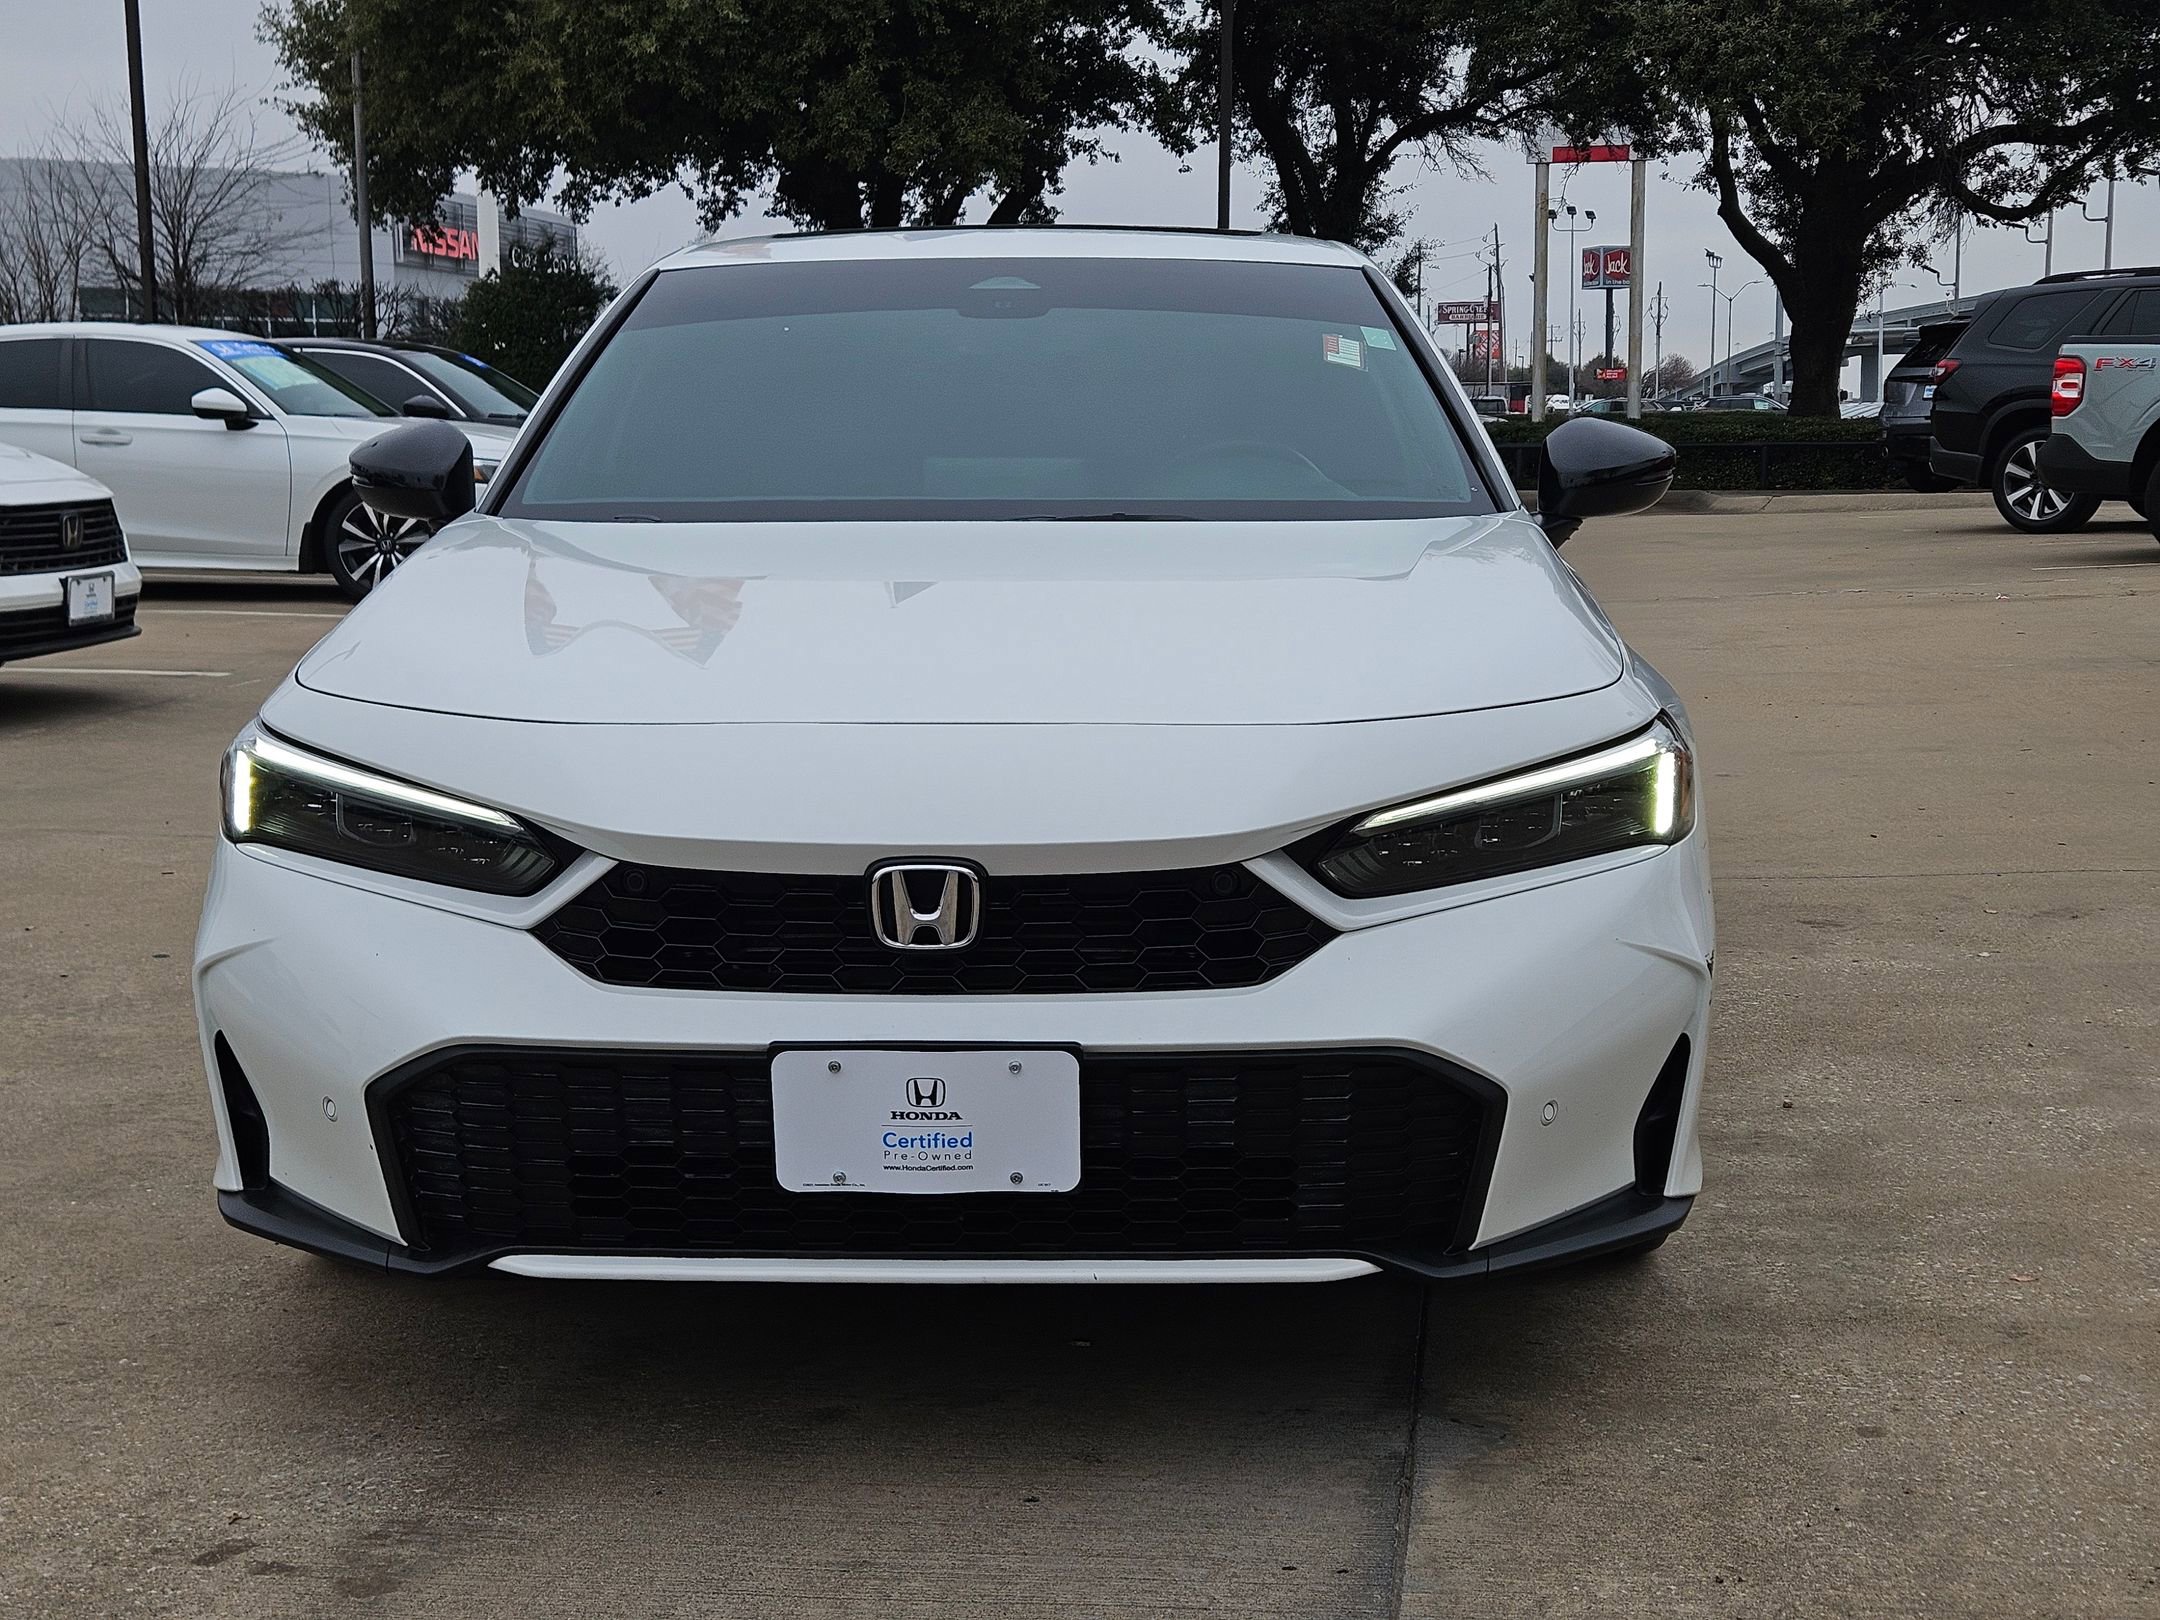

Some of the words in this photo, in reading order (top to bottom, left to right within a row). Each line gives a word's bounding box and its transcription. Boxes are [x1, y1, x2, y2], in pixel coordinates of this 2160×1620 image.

[1604, 252, 1631, 275] Jack
[1442, 304, 1469, 314] SPRING
[2094, 357, 2157, 371] FX4
[890, 1110, 963, 1121] HONDA
[882, 1131, 973, 1149] Certified
[883, 1150, 972, 1161] Pre-Owned
[882, 1164, 974, 1172] www.HondaCertified.com
